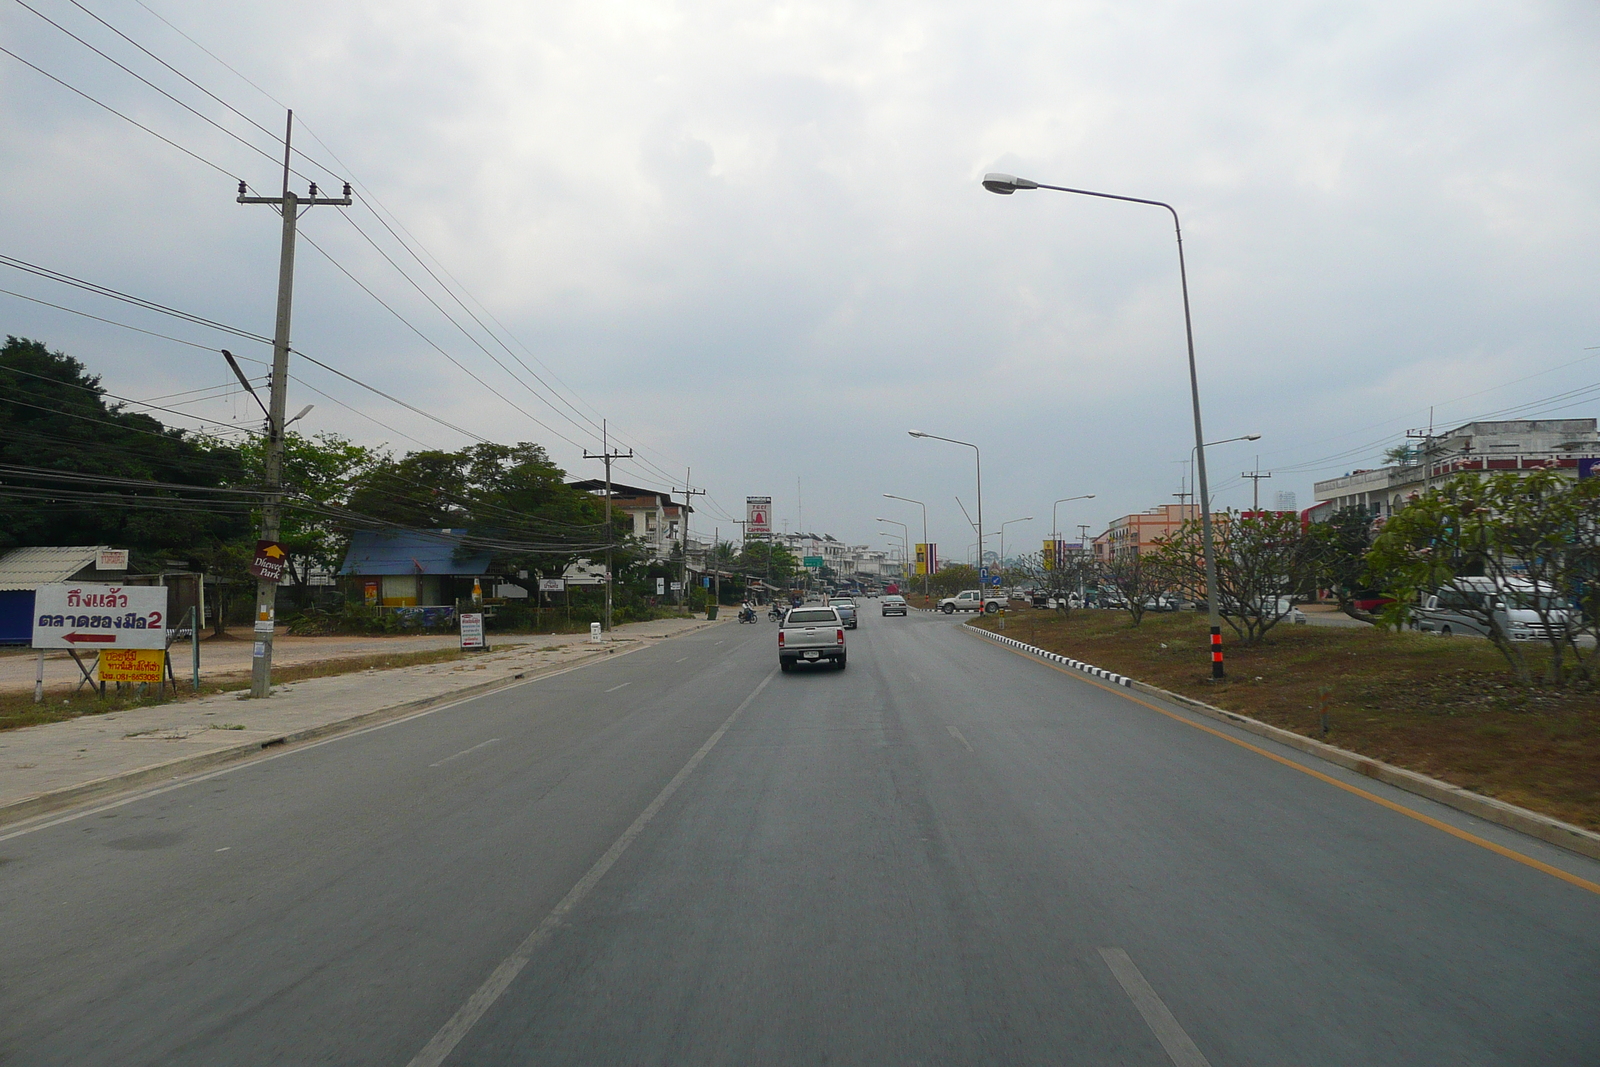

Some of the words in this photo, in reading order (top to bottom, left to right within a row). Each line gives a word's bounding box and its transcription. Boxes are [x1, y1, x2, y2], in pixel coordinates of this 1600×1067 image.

[260, 568, 281, 580] Park
[67, 587, 128, 608] ถึงแล้ว
